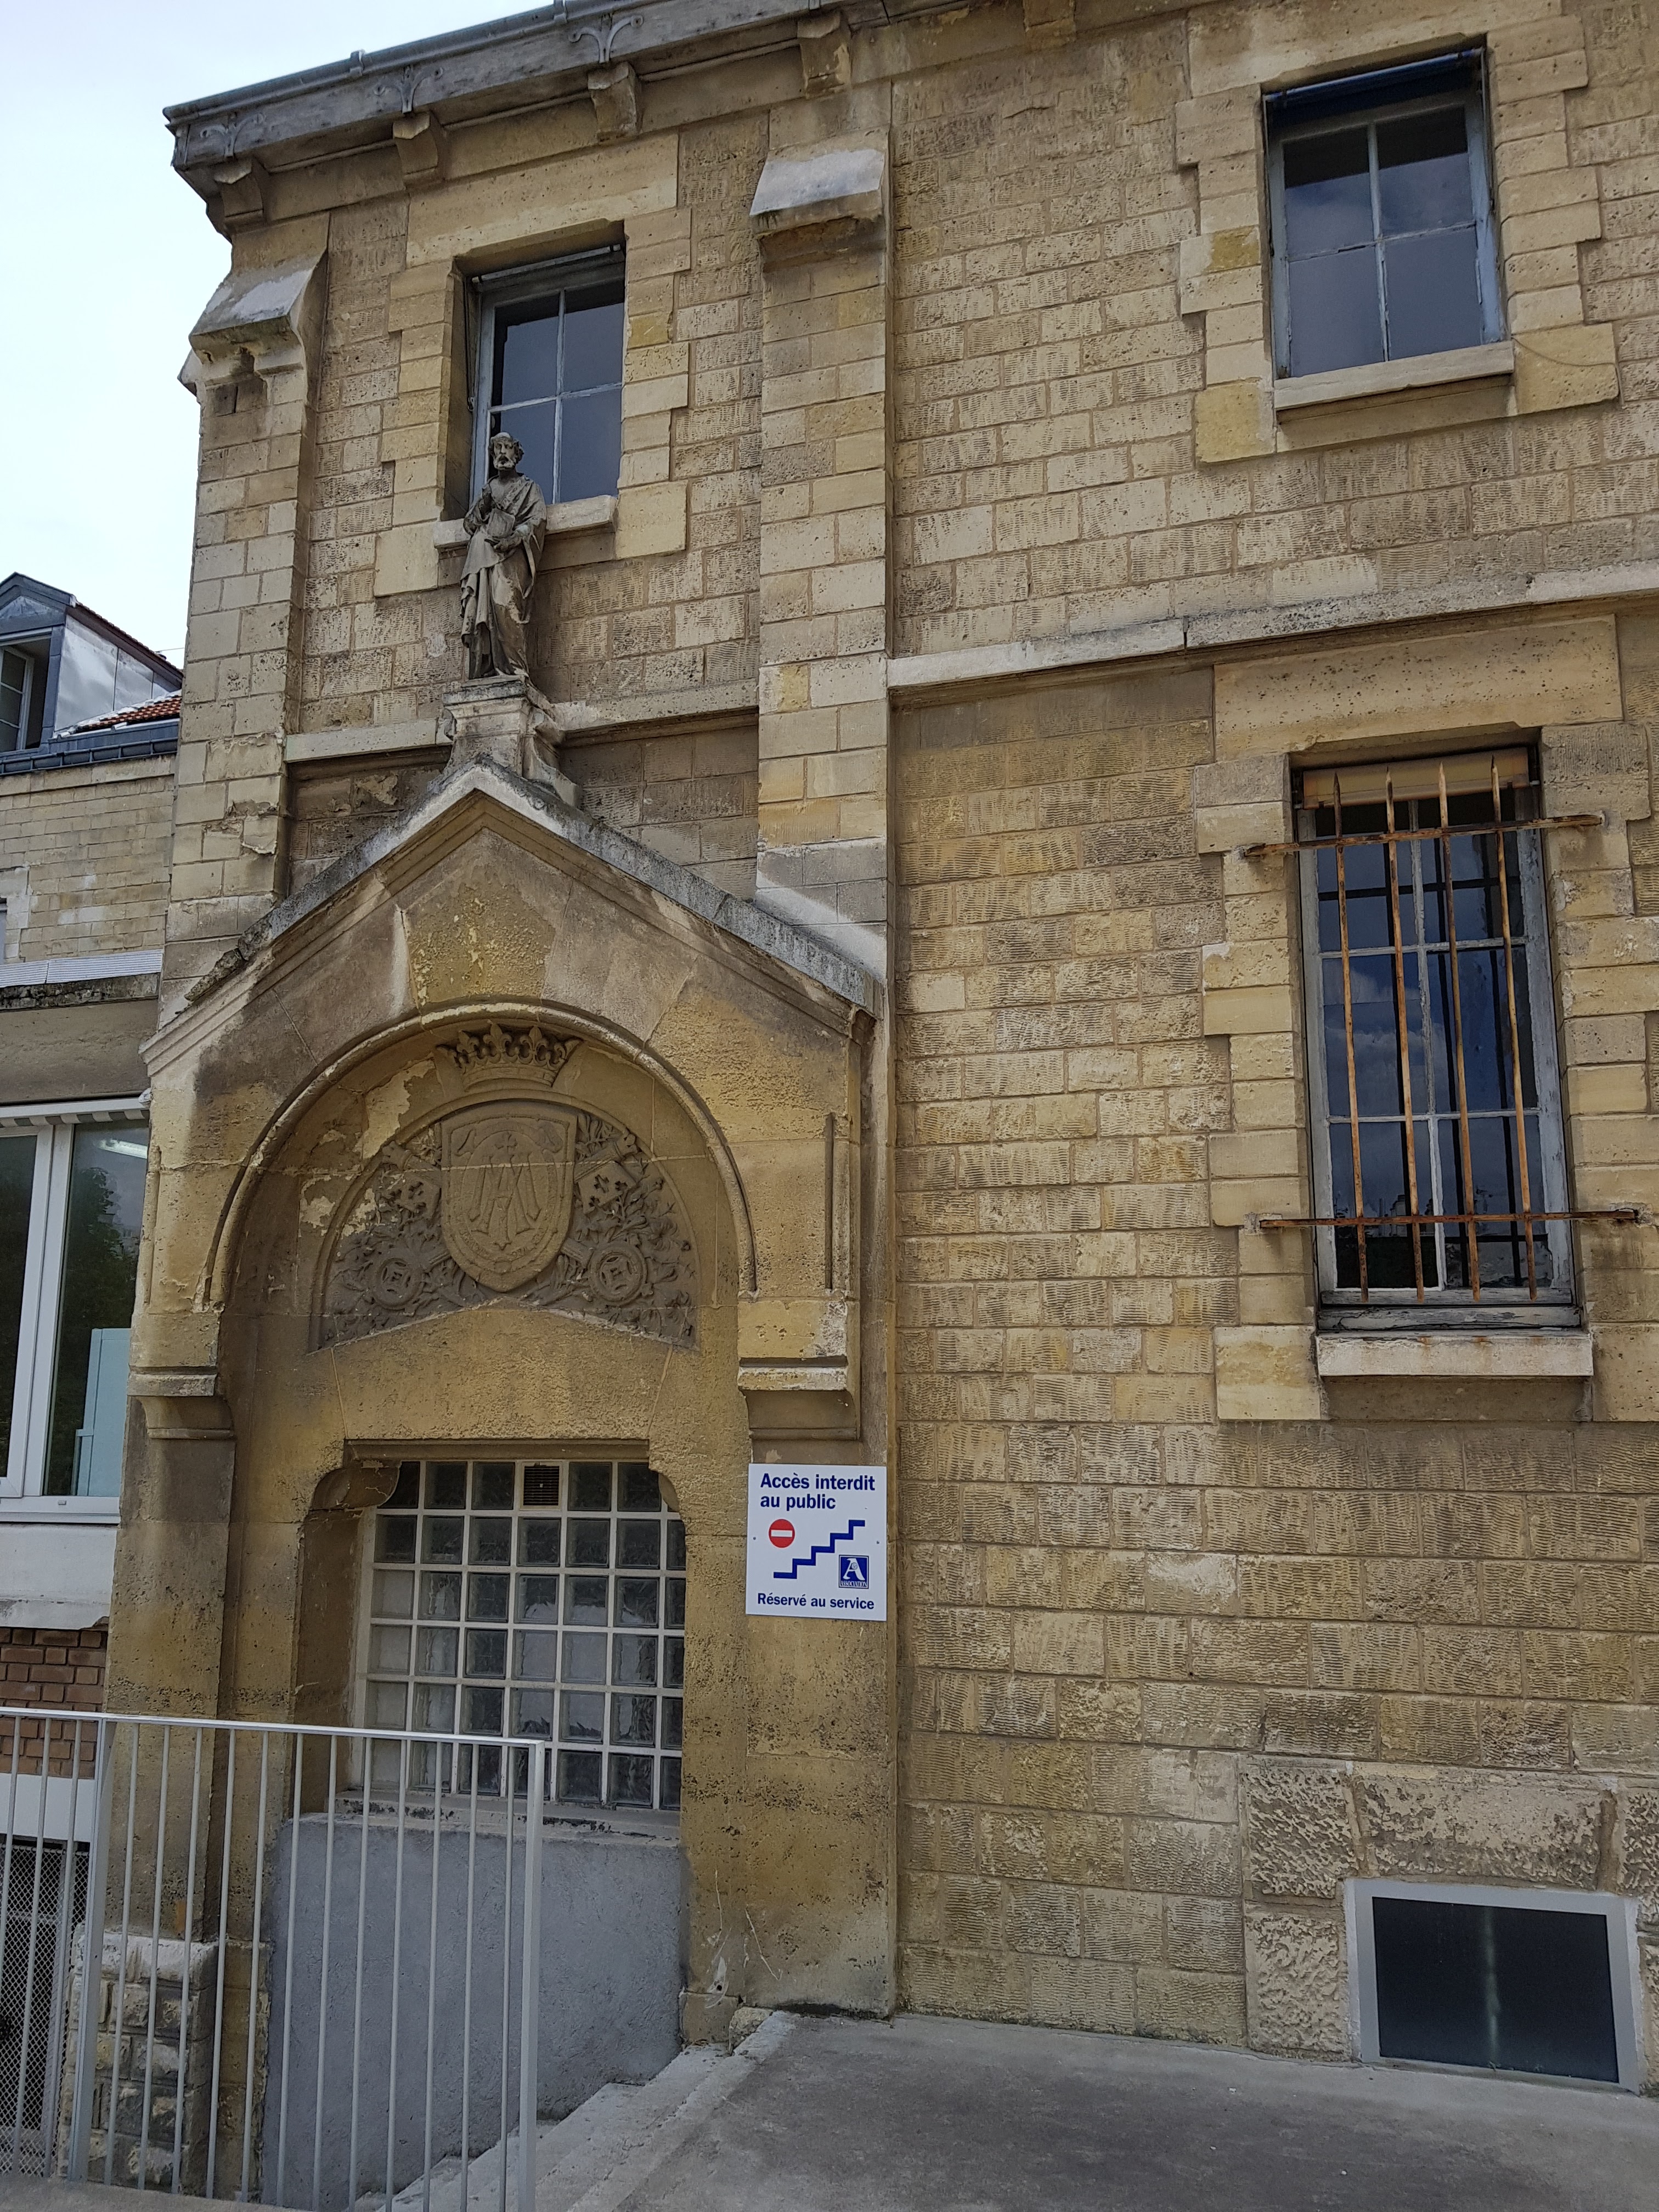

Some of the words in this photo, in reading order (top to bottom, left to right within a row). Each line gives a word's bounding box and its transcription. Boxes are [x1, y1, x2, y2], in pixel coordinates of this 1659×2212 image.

[760, 1472, 810, 1489] Accès
[815, 1474, 876, 1491] interdit
[760, 1496, 780, 1508] au
[786, 1493, 836, 1511] public
[758, 1592, 807, 1606] Réservé
[810, 1598, 826, 1607] au
[830, 1596, 874, 1610] service
